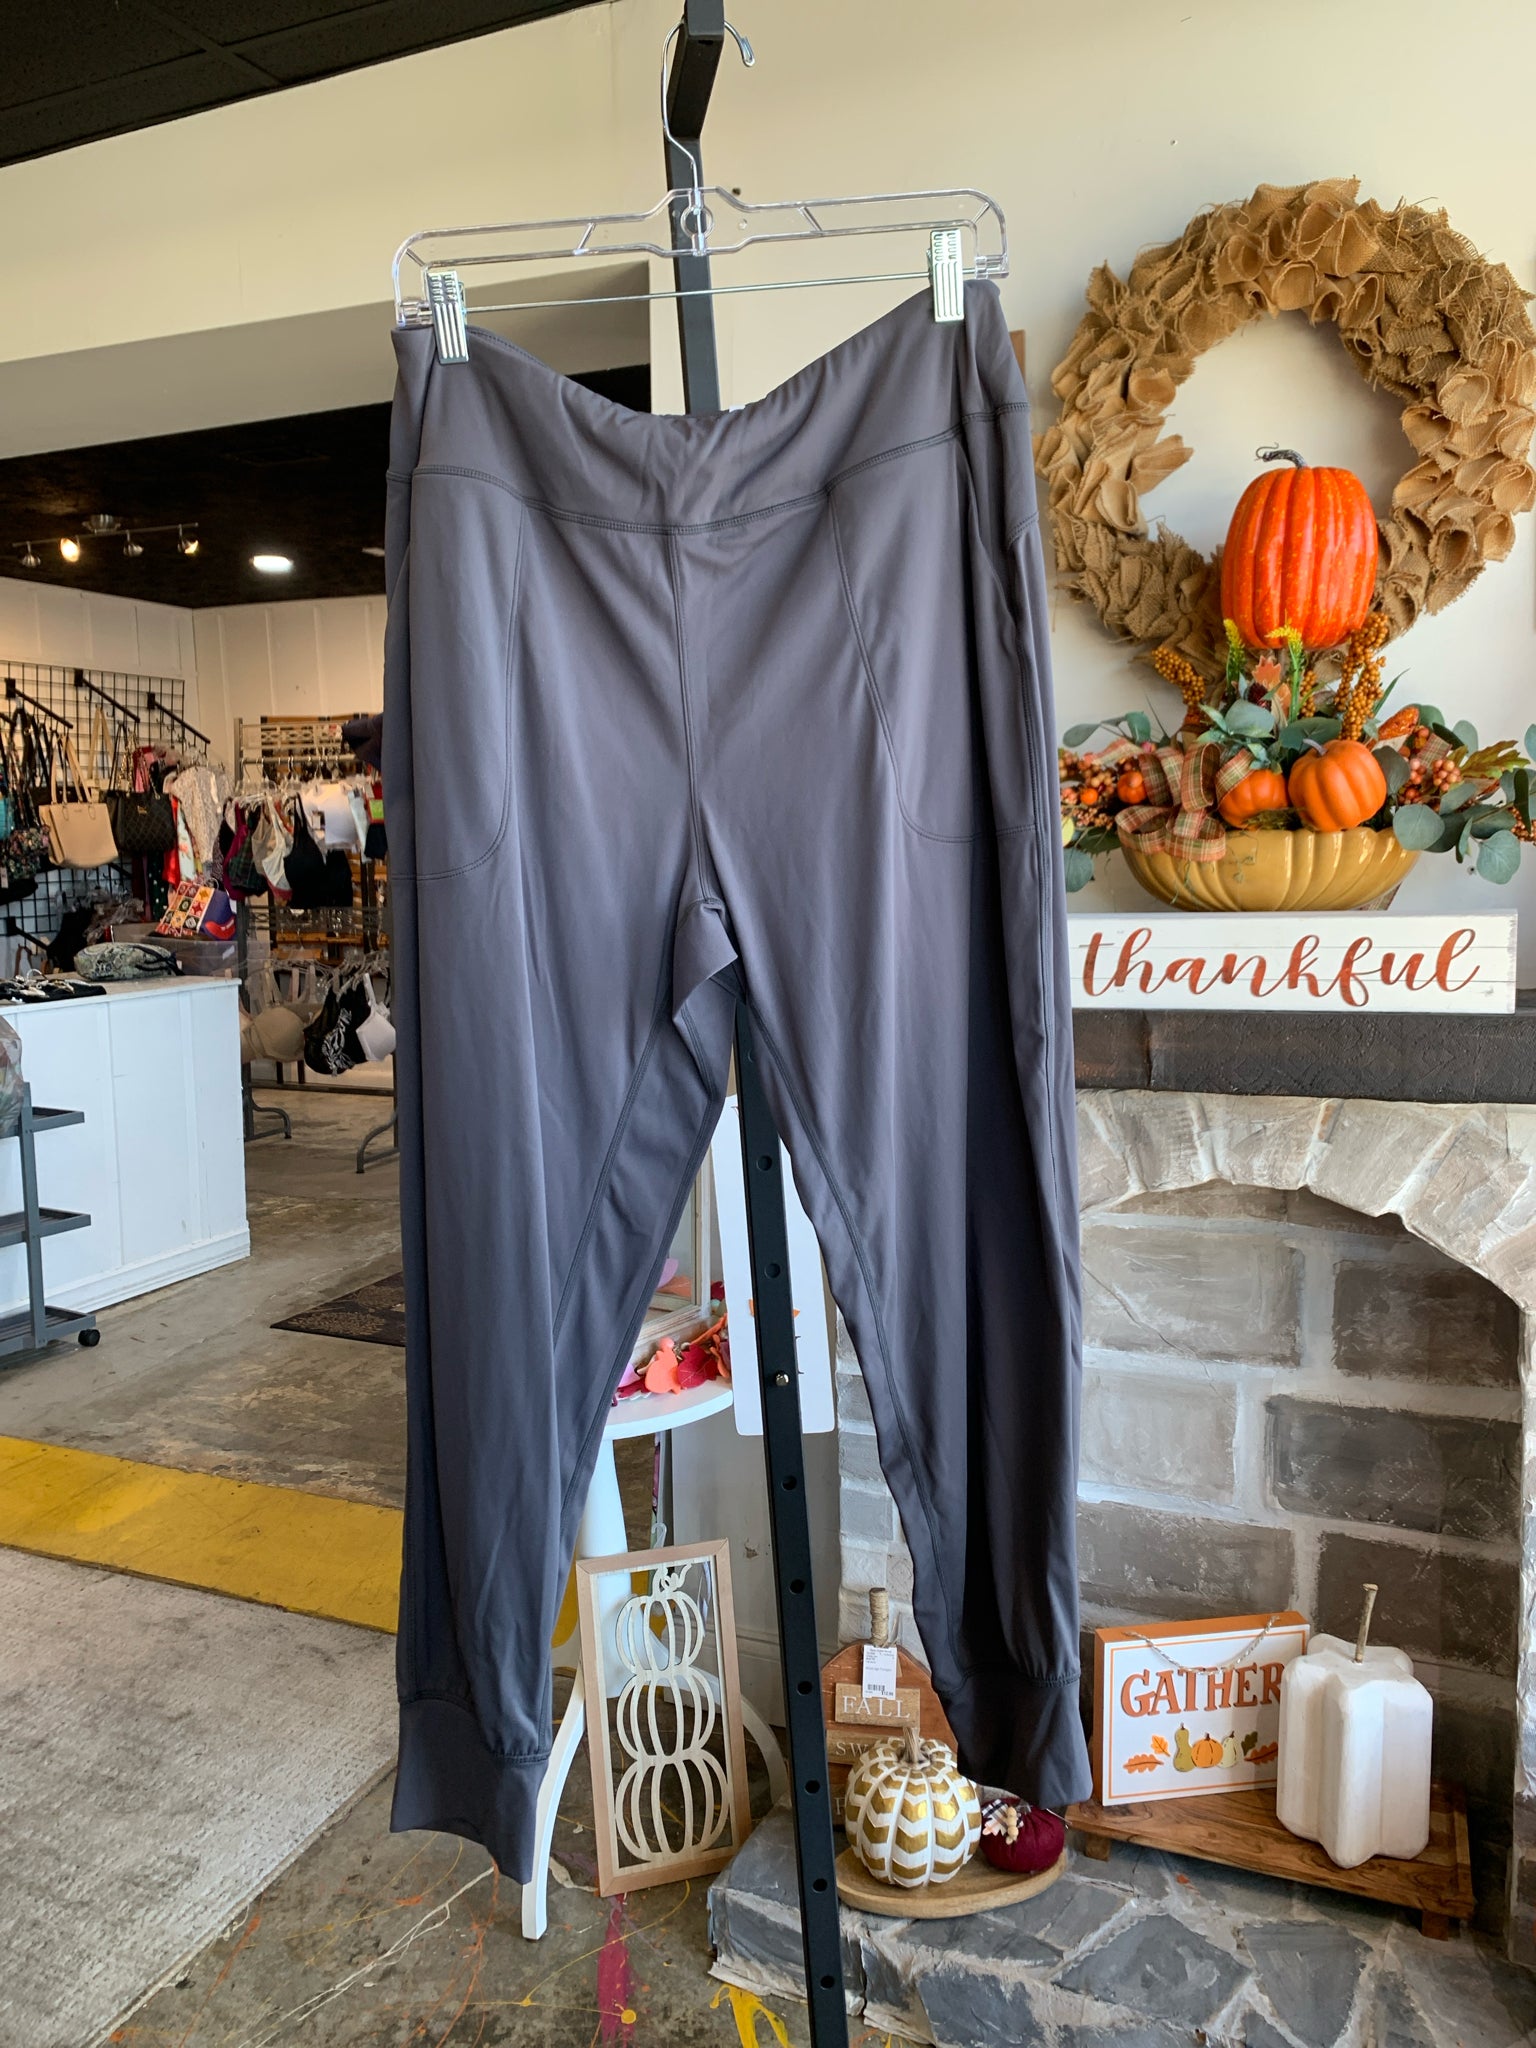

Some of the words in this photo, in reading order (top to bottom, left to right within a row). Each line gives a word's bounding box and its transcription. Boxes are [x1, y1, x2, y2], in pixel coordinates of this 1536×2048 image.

[1079, 927, 1481, 1007] thankful
[842, 1695, 911, 1719] FALL
[1120, 1662, 1285, 1718] GATHER
